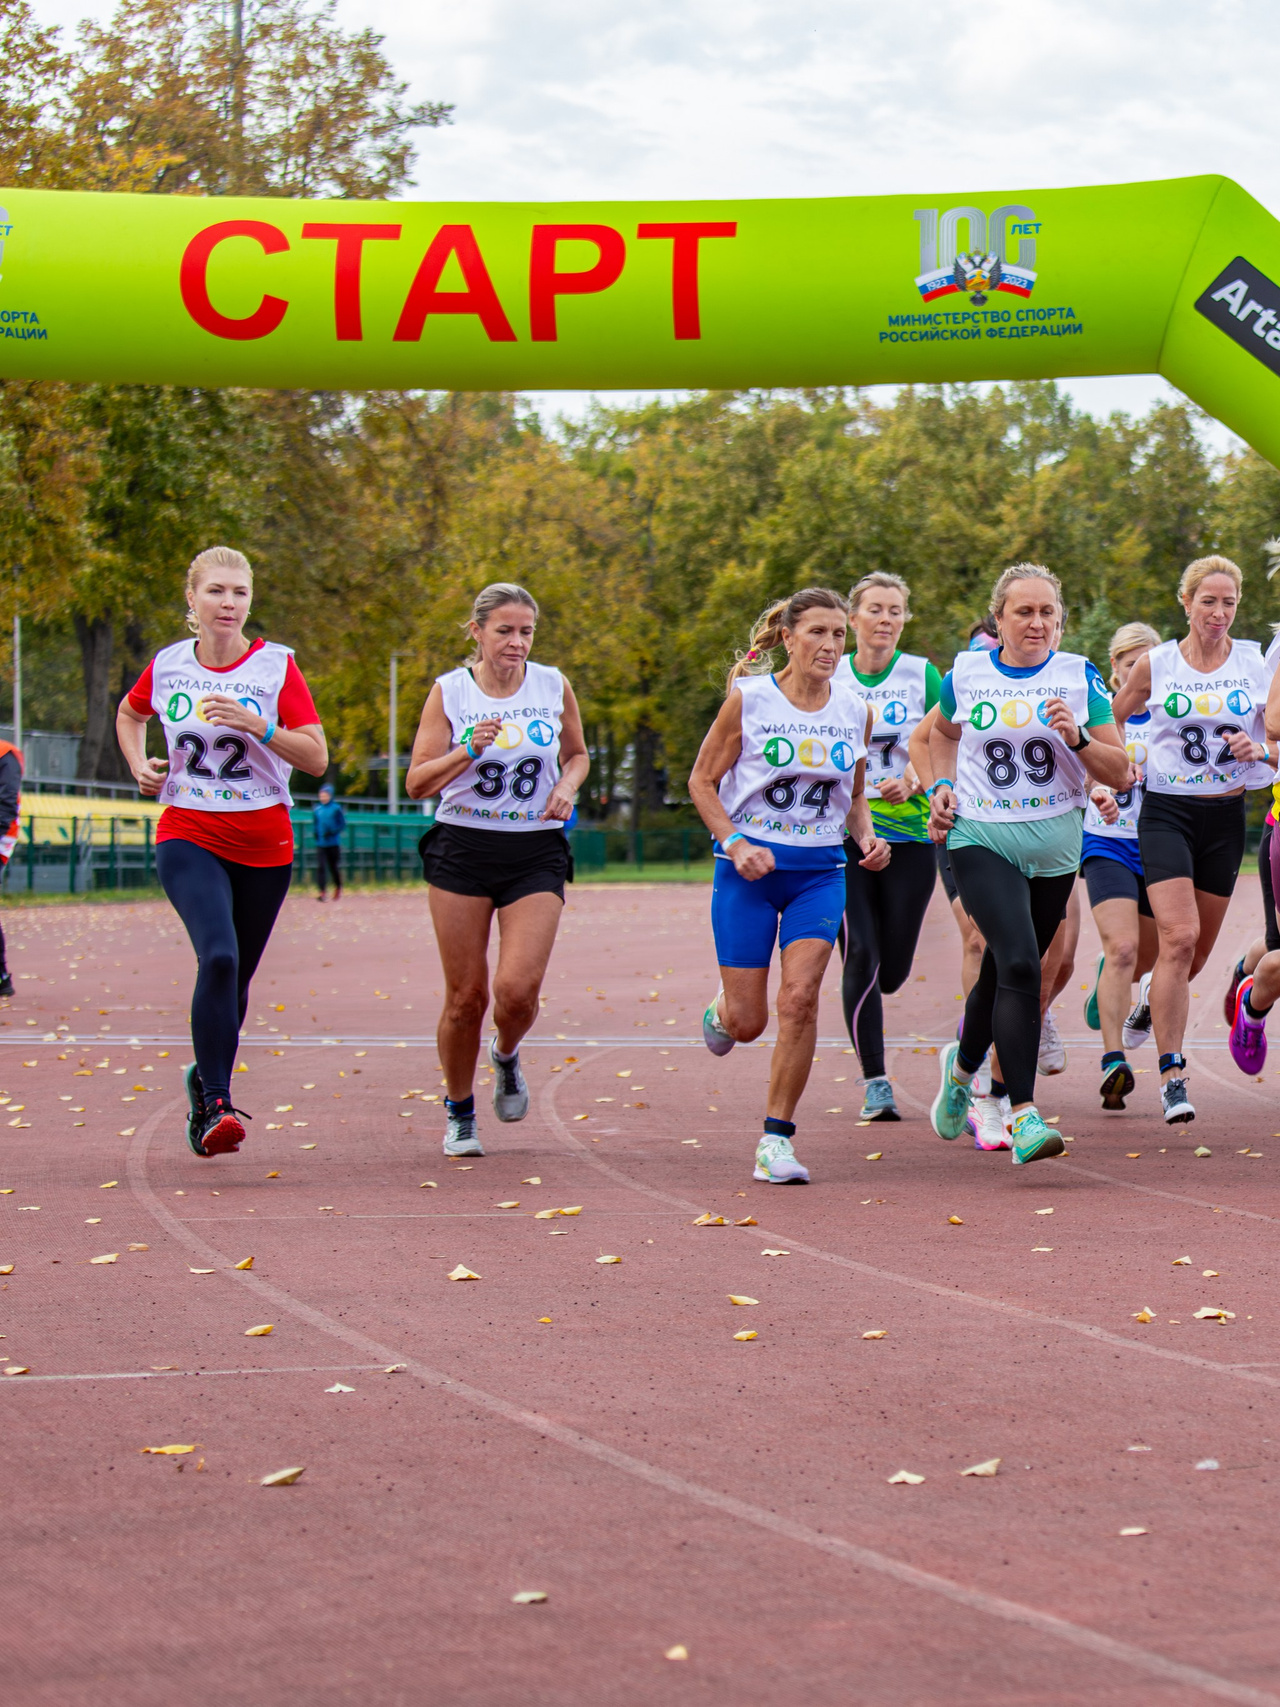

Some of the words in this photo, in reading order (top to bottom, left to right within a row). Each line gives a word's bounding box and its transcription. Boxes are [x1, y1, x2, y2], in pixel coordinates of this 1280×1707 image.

[1010, 223, 1043, 235] ЛЕТ
[180, 220, 737, 342] СТАРТ
[926, 278, 948, 291] 1923
[1004, 274, 1028, 289] 2023
[0, 310, 40, 324] ОРТА
[888, 310, 1011, 327] МИНИСТЕРСТВО
[1015, 307, 1076, 321] СПОРТА
[879, 324, 981, 343] РОССИЙСКОЙ
[986, 323, 1083, 339] ФЕДЕРАЦИИ
[168, 679, 266, 697] VMARAFONE
[969, 687, 1068, 701] VMARAFONE
[1165, 678, 1250, 693] VMARAFONE
[761, 723, 853, 740] VMARAFONE
[175, 731, 253, 782] 22
[865, 732, 902, 772] 7
[982, 736, 1058, 789] 89
[471, 755, 545, 802] 88
